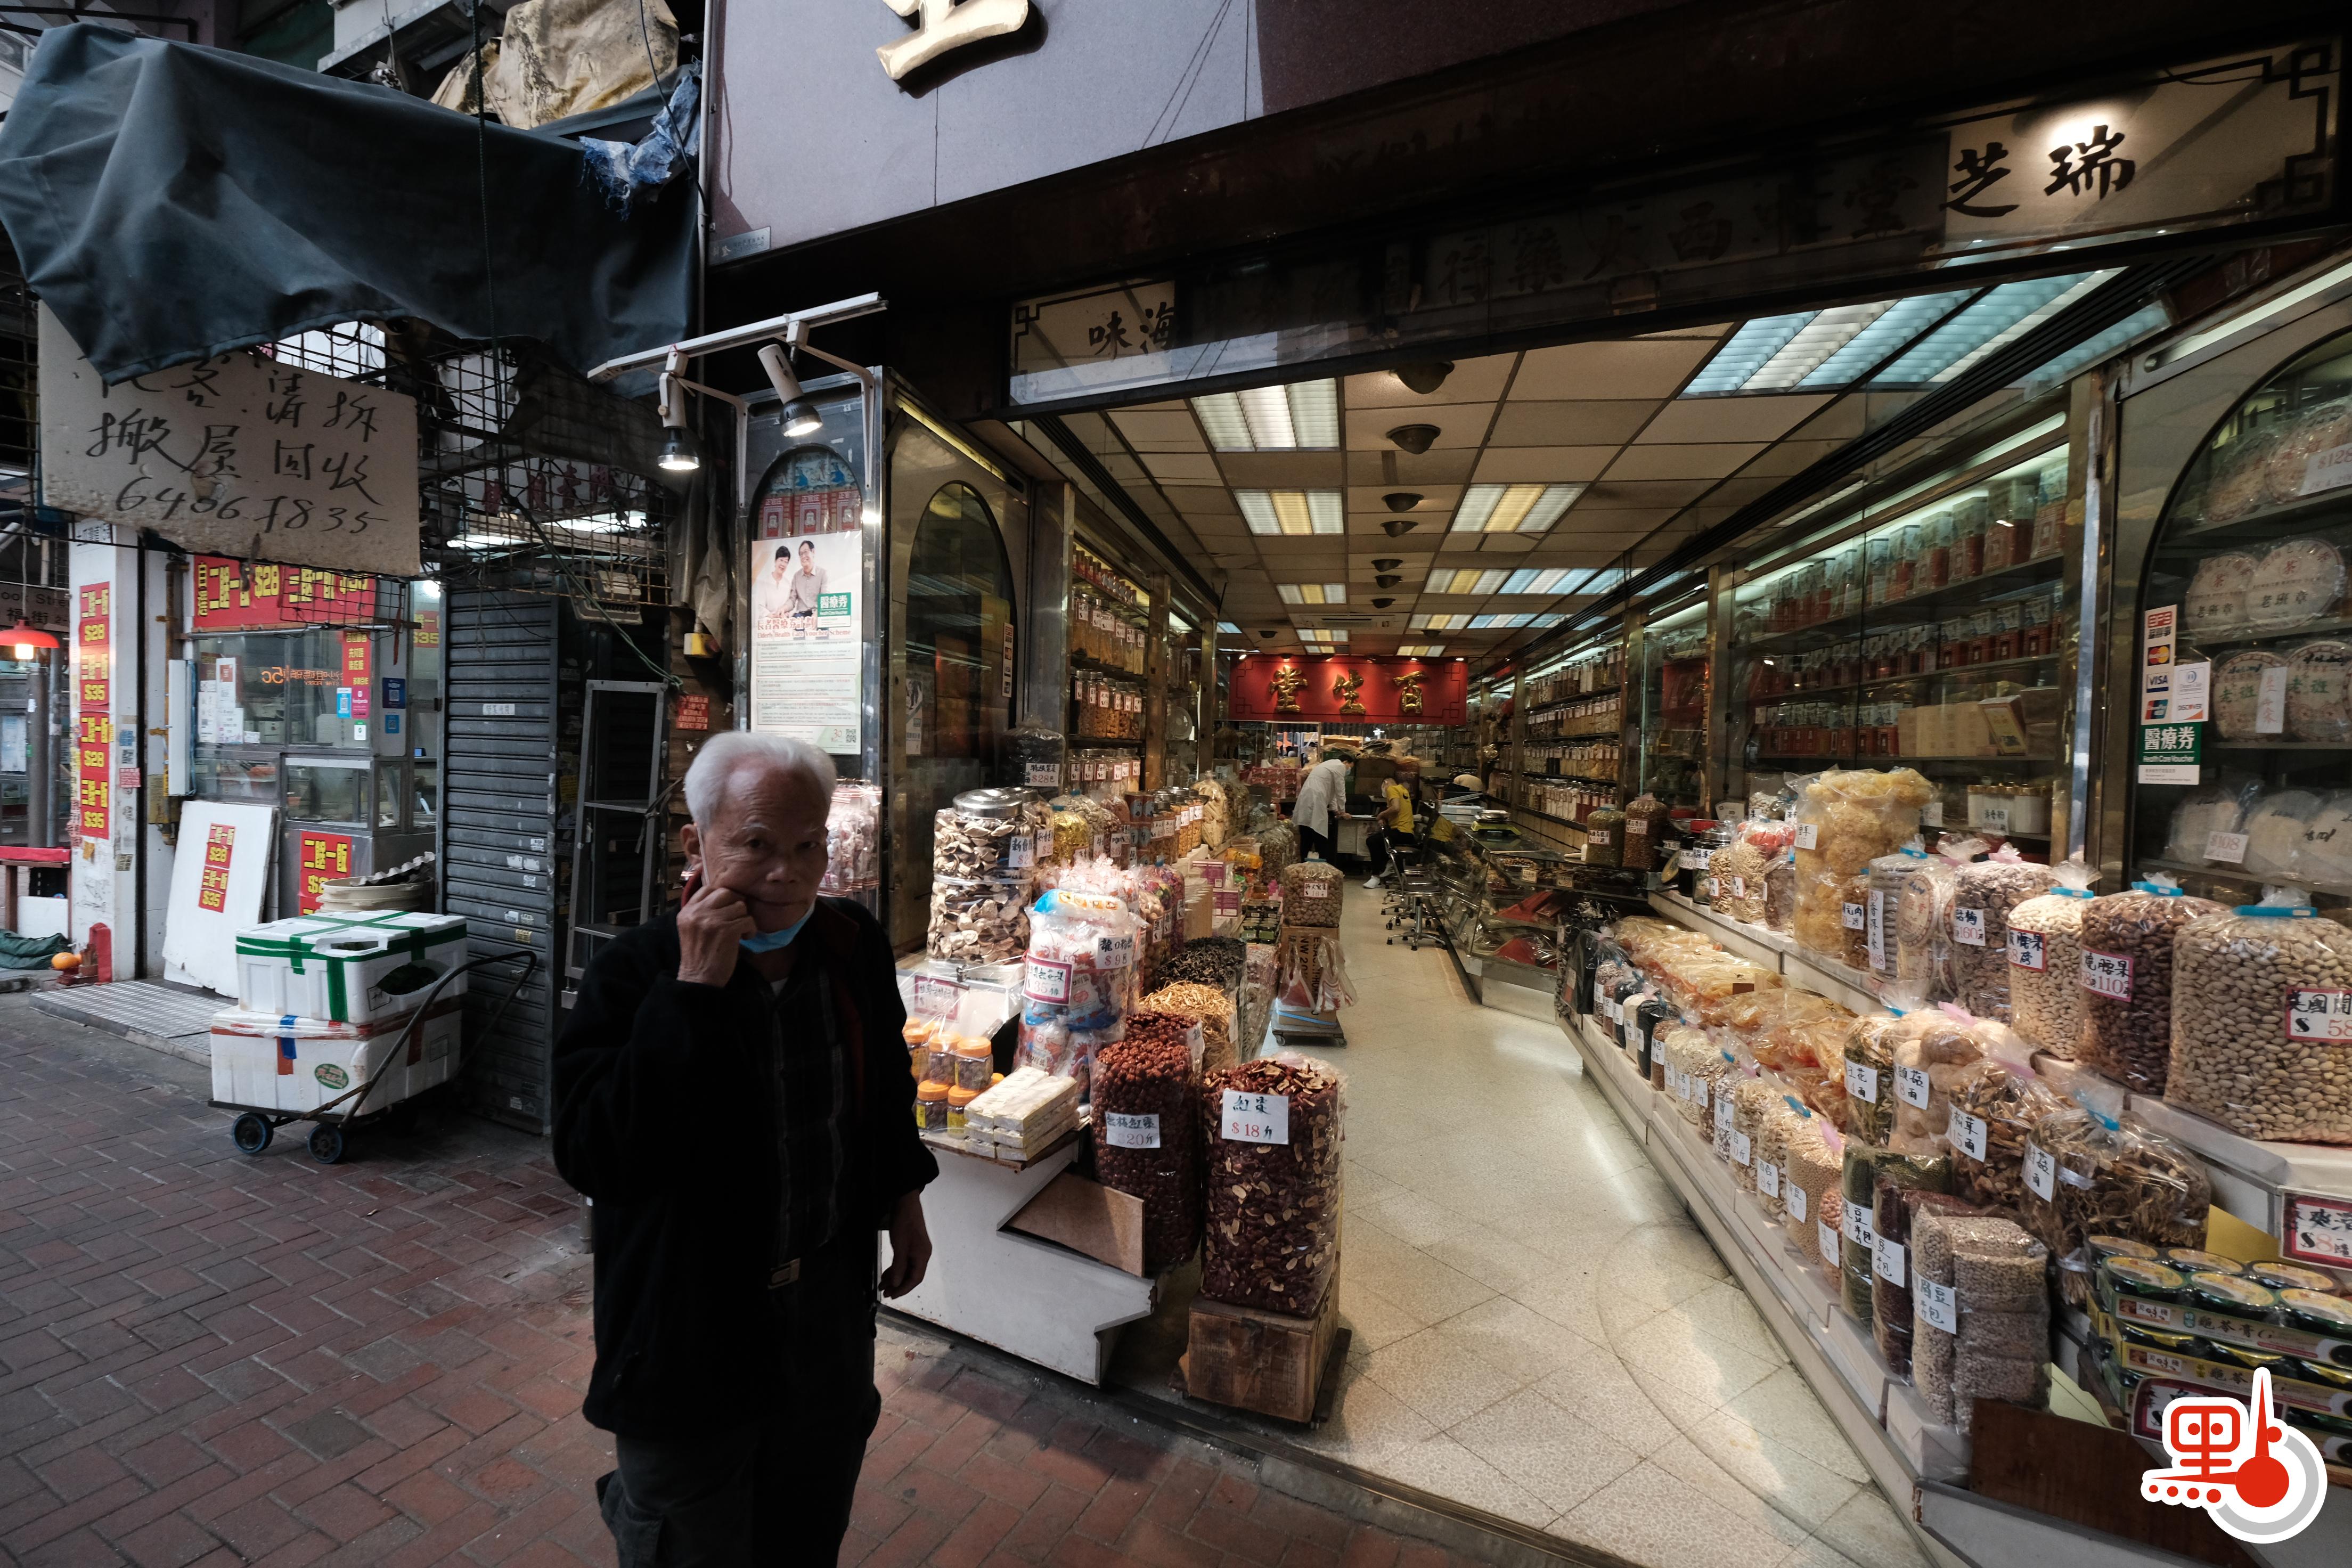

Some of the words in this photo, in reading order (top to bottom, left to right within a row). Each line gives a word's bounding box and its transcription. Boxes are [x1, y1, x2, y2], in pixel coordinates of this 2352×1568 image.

[820, 595, 848, 609] 醫療券
[2149, 674, 2168, 687] VISA
[2144, 726, 2195, 751] 醫療券
[1104, 953, 1128, 966] $98
